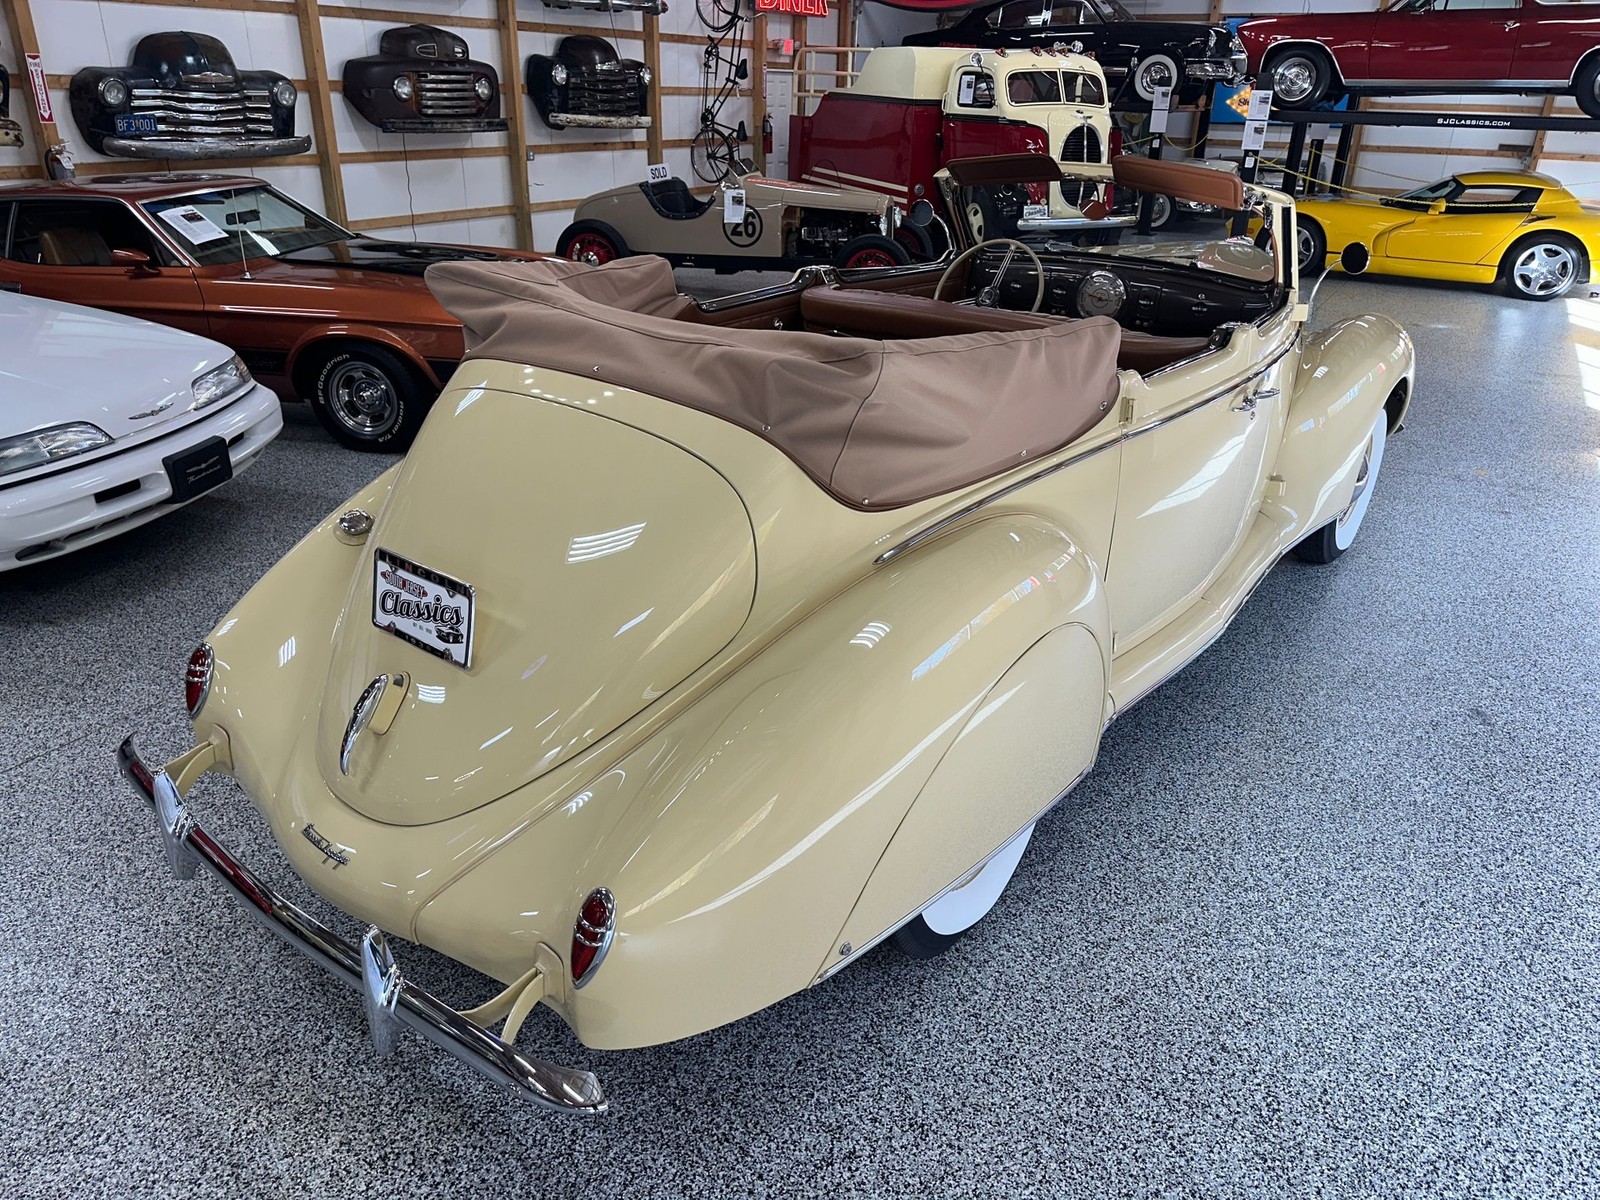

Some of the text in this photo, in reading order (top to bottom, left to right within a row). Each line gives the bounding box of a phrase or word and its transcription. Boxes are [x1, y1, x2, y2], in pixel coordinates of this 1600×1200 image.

[139, 119, 156, 131] 001
[650, 166, 668, 180] SOLD
[730, 211, 757, 238] 26
[317, 353, 350, 405] BFGoodrich
[379, 588, 465, 627] Classics
